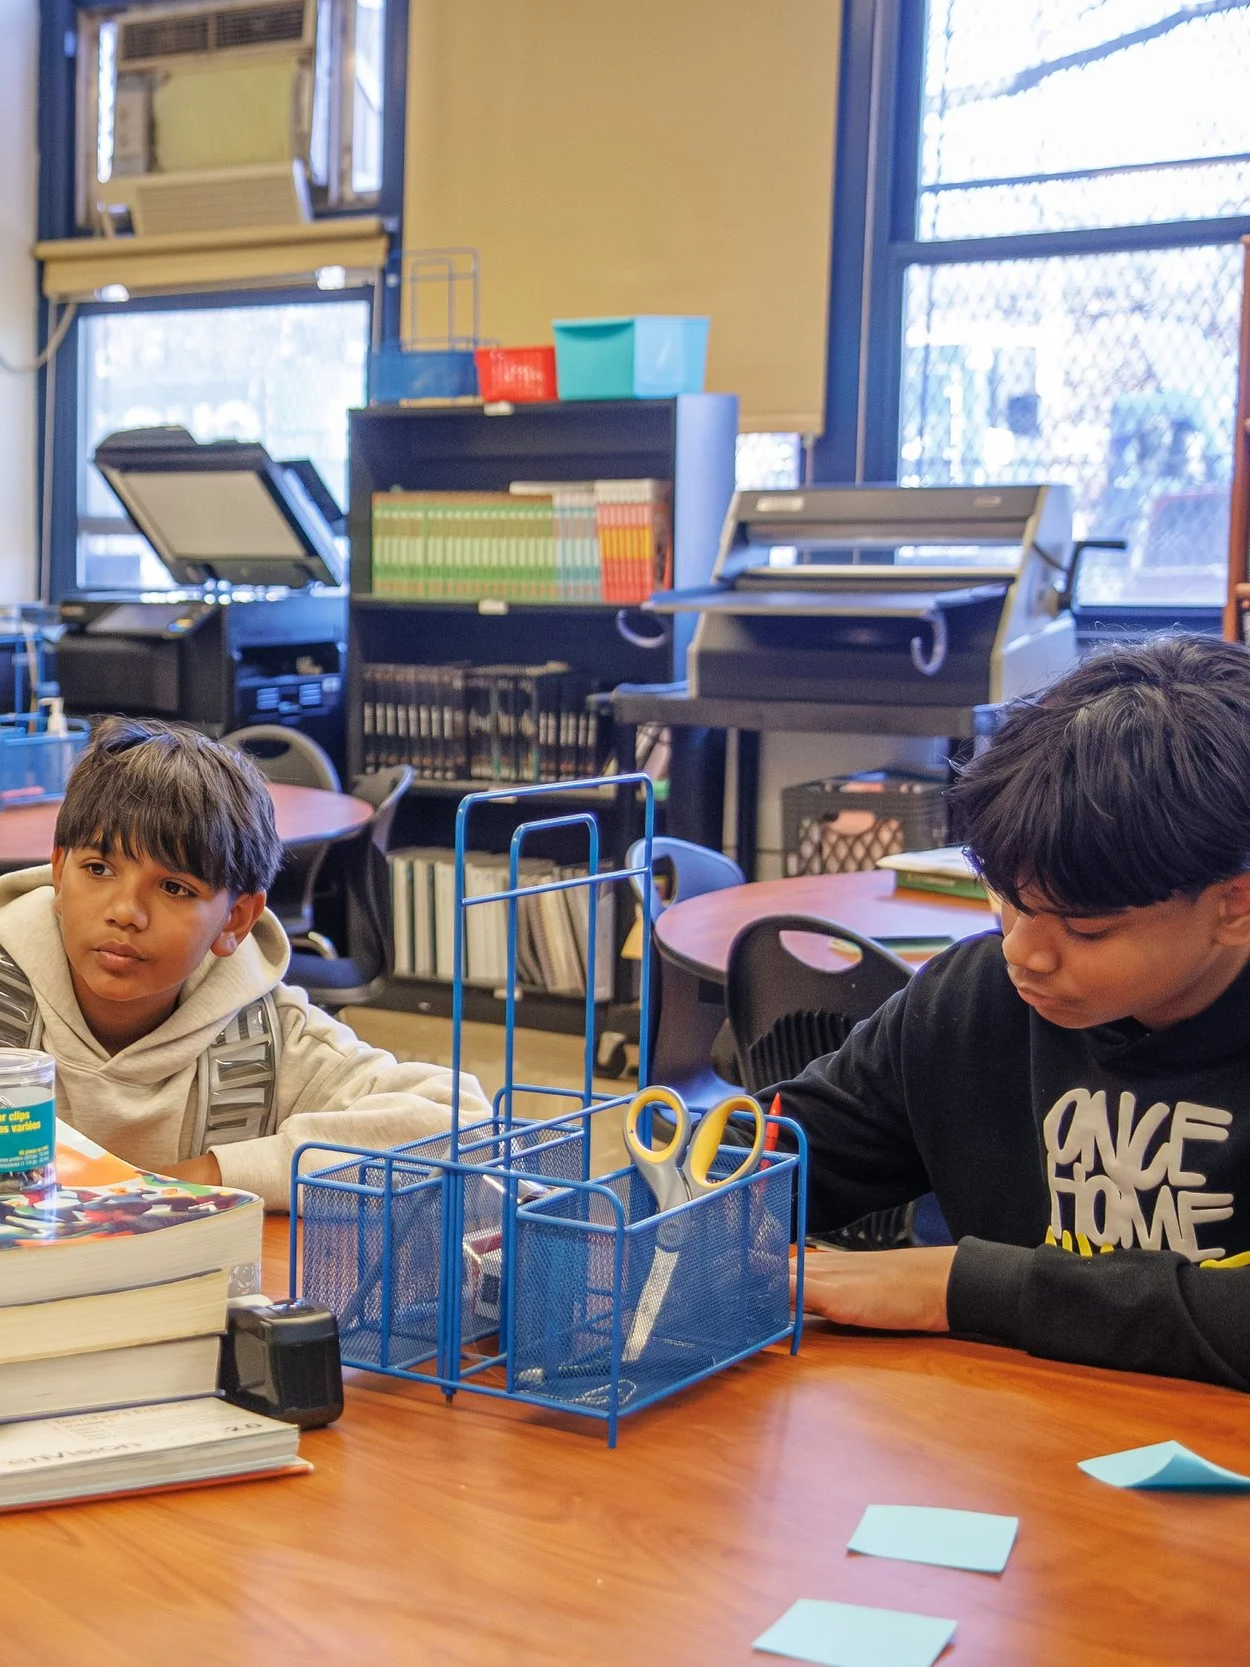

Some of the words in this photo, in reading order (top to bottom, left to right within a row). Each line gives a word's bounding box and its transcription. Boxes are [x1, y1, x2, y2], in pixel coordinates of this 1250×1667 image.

[9, 1111, 30, 1123] clips
[1043, 1088, 1233, 1190] ONCE
[1047, 1162, 1235, 1263] HOME
